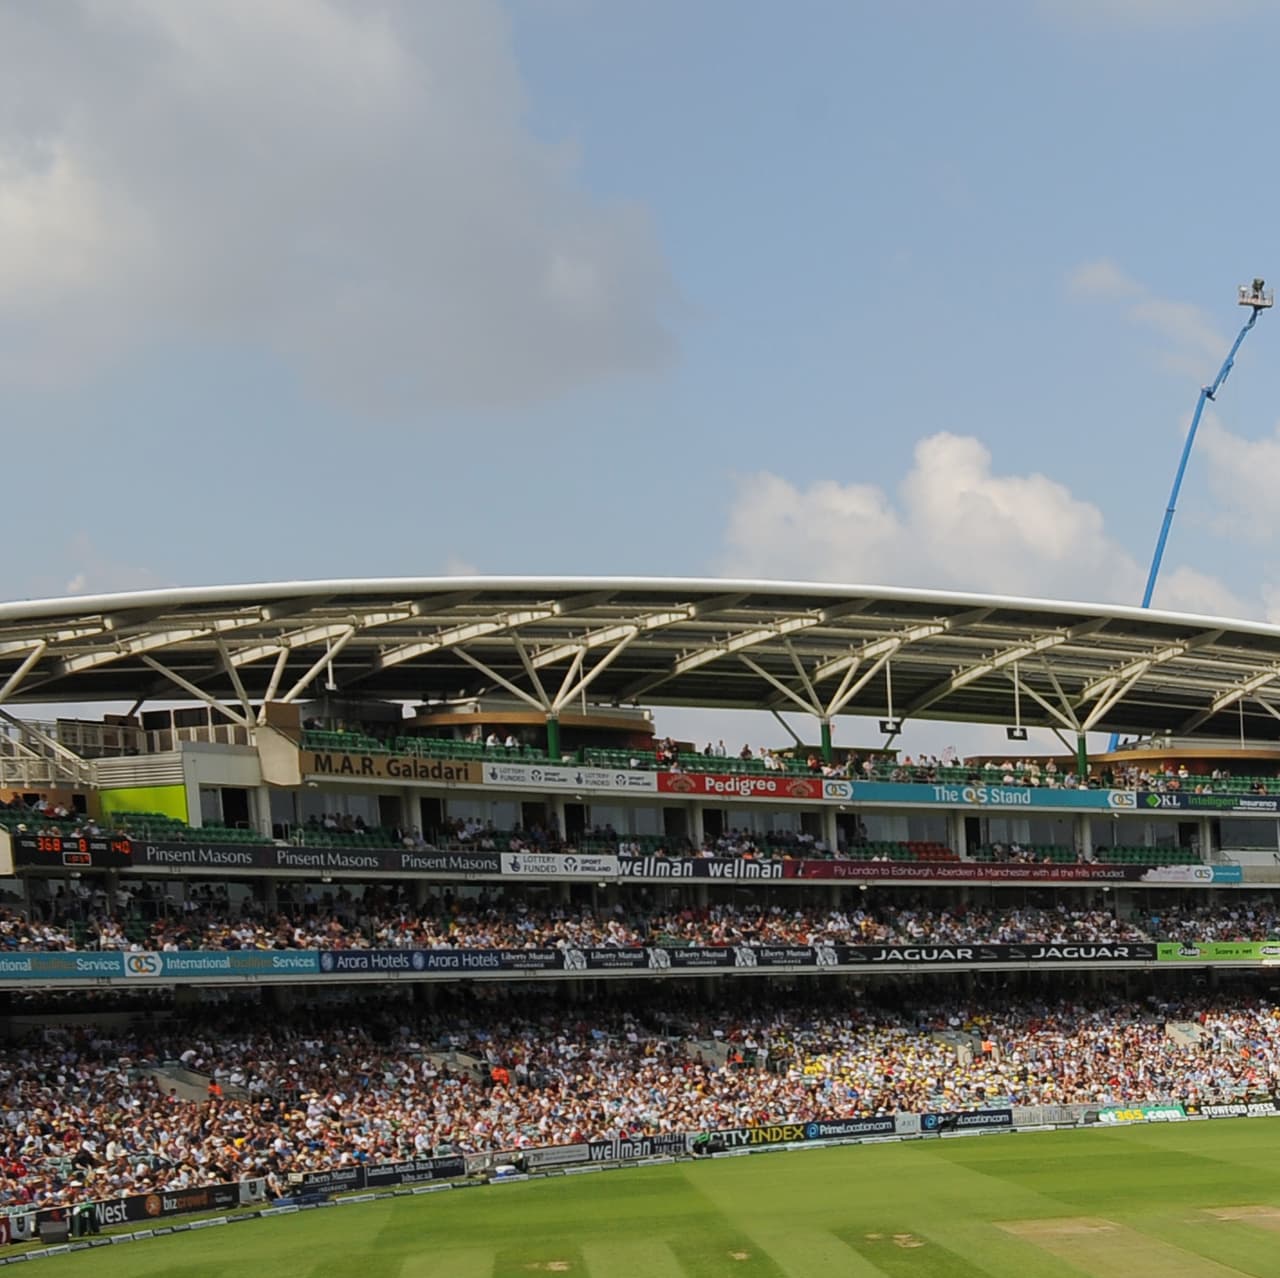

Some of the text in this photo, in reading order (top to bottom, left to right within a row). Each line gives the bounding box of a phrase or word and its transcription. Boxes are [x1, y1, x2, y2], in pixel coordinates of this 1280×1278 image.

[314, 753, 470, 781] M.A.R. Galadari
[704, 778, 776, 796] Pedigree
[933, 785, 958, 802] The
[991, 788, 1031, 805] Stand
[38, 837, 62, 851] 368
[146, 846, 253, 864] Pinsent Masons
[277, 851, 379, 867] Pinsent Masons
[401, 854, 498, 870] Pinsent Masons
[523, 856, 556, 864] LOTTERY
[523, 864, 558, 873] FUNDED
[617, 858, 693, 877] wellman
[708, 859, 783, 879] wellman
[849, 865, 879, 875] London
[428, 953, 499, 968] Arora Hotels
[872, 949, 973, 961] JAGUAR
[1031, 947, 1129, 959] JAGUAR
[76, 955, 120, 971] Services
[127, 955, 157, 973] OCS
[166, 955, 231, 970] International
[272, 955, 315, 968] Services
[337, 954, 410, 969] Arora Hotels
[1099, 1106, 1181, 1122] et365.com
[1201, 1102, 1276, 1116] STOWFORD PRESS
[751, 1125, 805, 1143] INDEX
[590, 1138, 651, 1161] wellman
